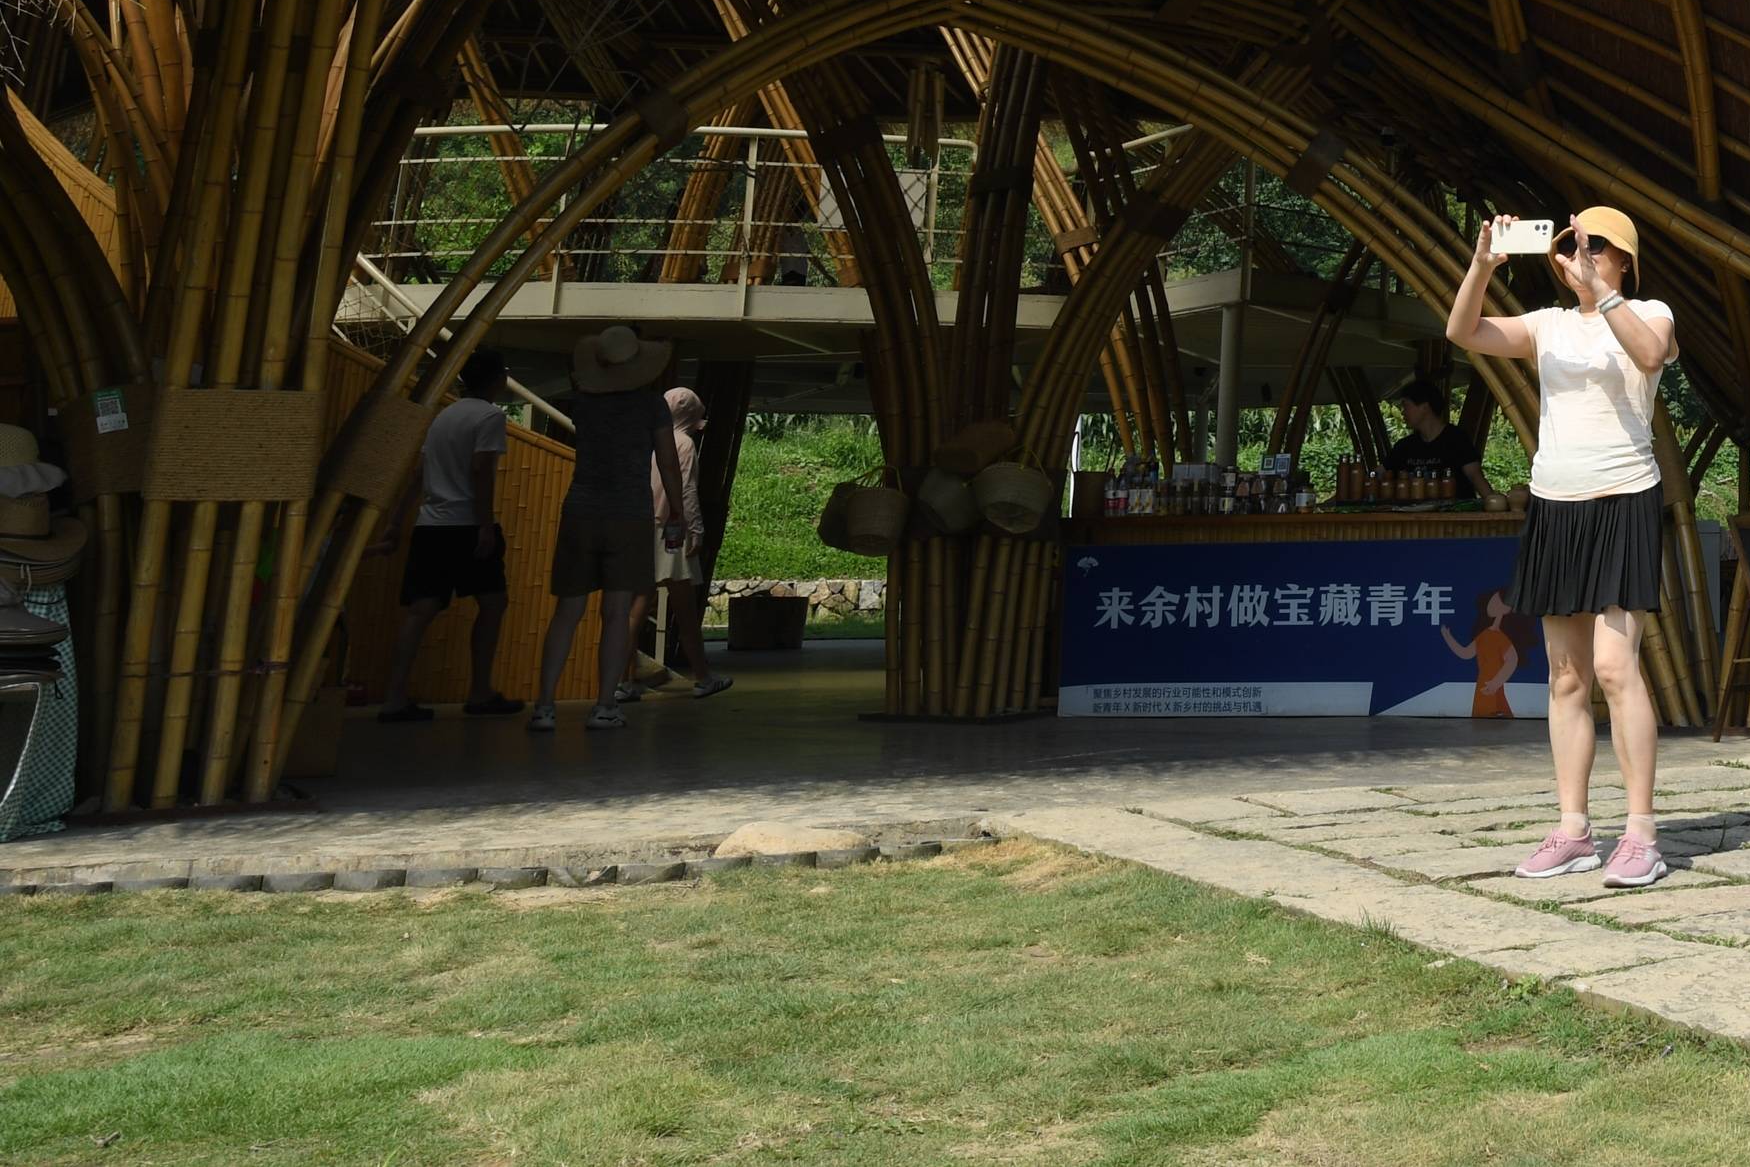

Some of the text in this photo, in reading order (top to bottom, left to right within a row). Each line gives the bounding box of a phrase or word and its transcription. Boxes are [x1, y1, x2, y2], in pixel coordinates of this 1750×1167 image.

[1093, 582, 1456, 630] 来余村做宝藏青年
[1093, 702, 1123, 713] 新青年
[1133, 702, 1162, 713] 新时代
